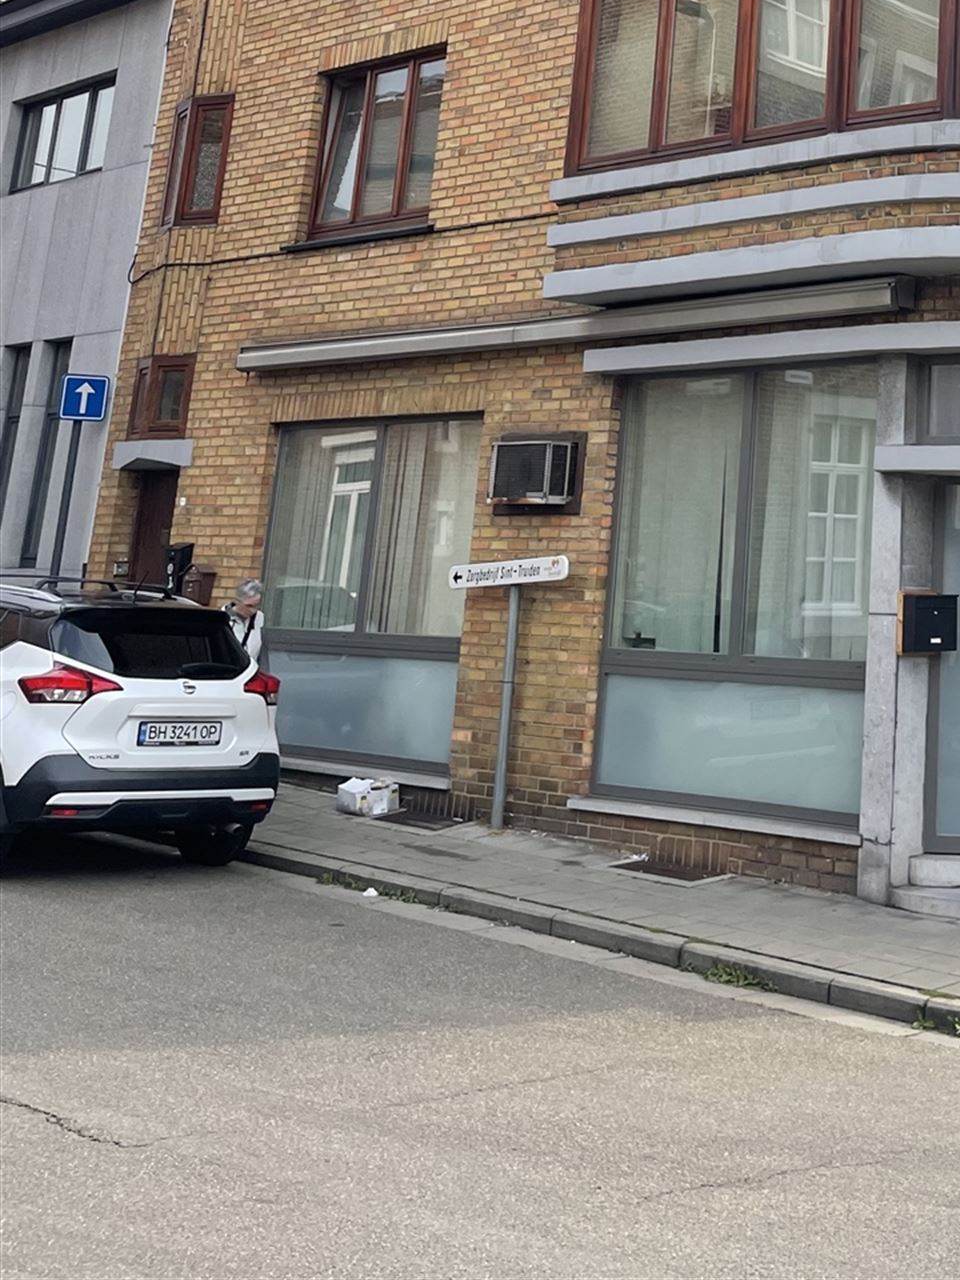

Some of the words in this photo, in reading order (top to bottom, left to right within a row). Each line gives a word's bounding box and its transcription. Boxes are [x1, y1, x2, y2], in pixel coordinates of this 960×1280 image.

[466, 566, 500, 584] Zorgbedrijf
[148, 725, 167, 740] BH
[169, 725, 198, 740] 3241
[199, 724, 218, 740] OP
